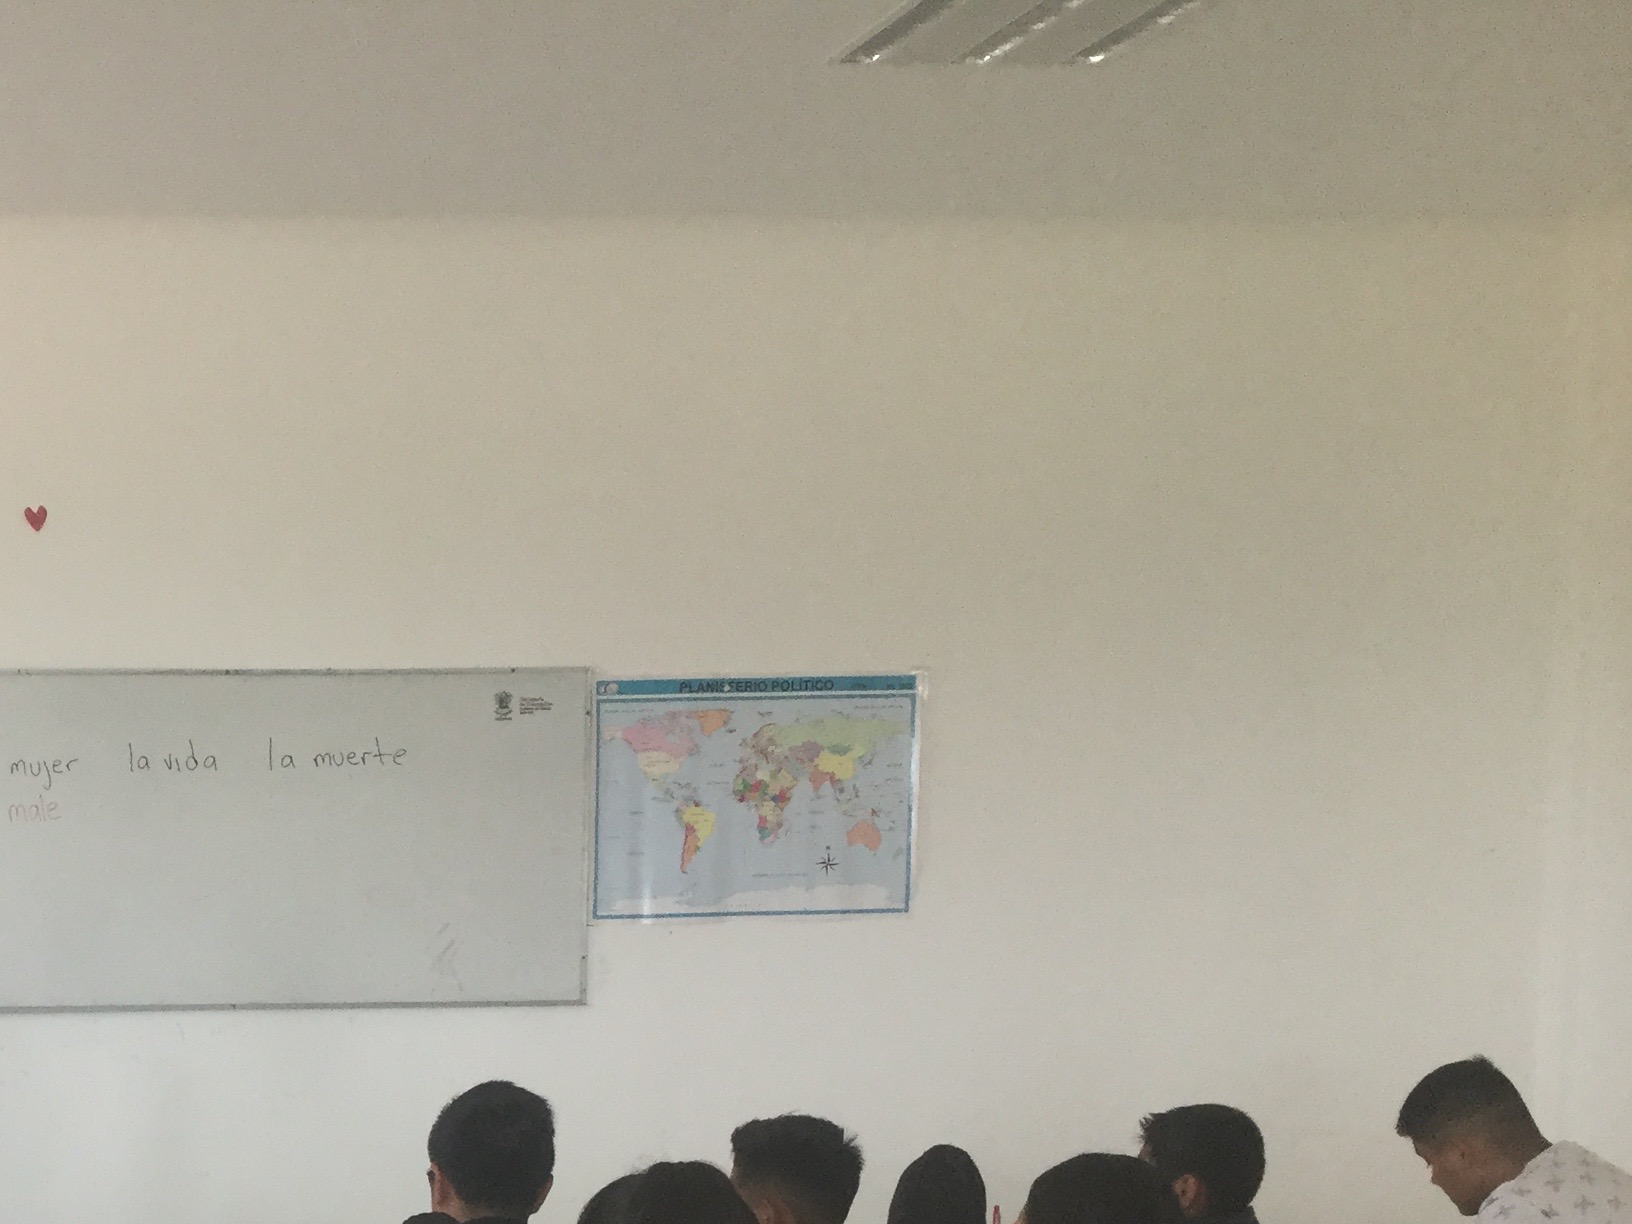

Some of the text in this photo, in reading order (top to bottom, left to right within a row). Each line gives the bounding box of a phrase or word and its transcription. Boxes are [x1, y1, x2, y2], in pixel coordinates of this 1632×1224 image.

[128, 738, 218, 773] la vida
[268, 736, 408, 772] la muerte
[9, 757, 79, 791] mujer
